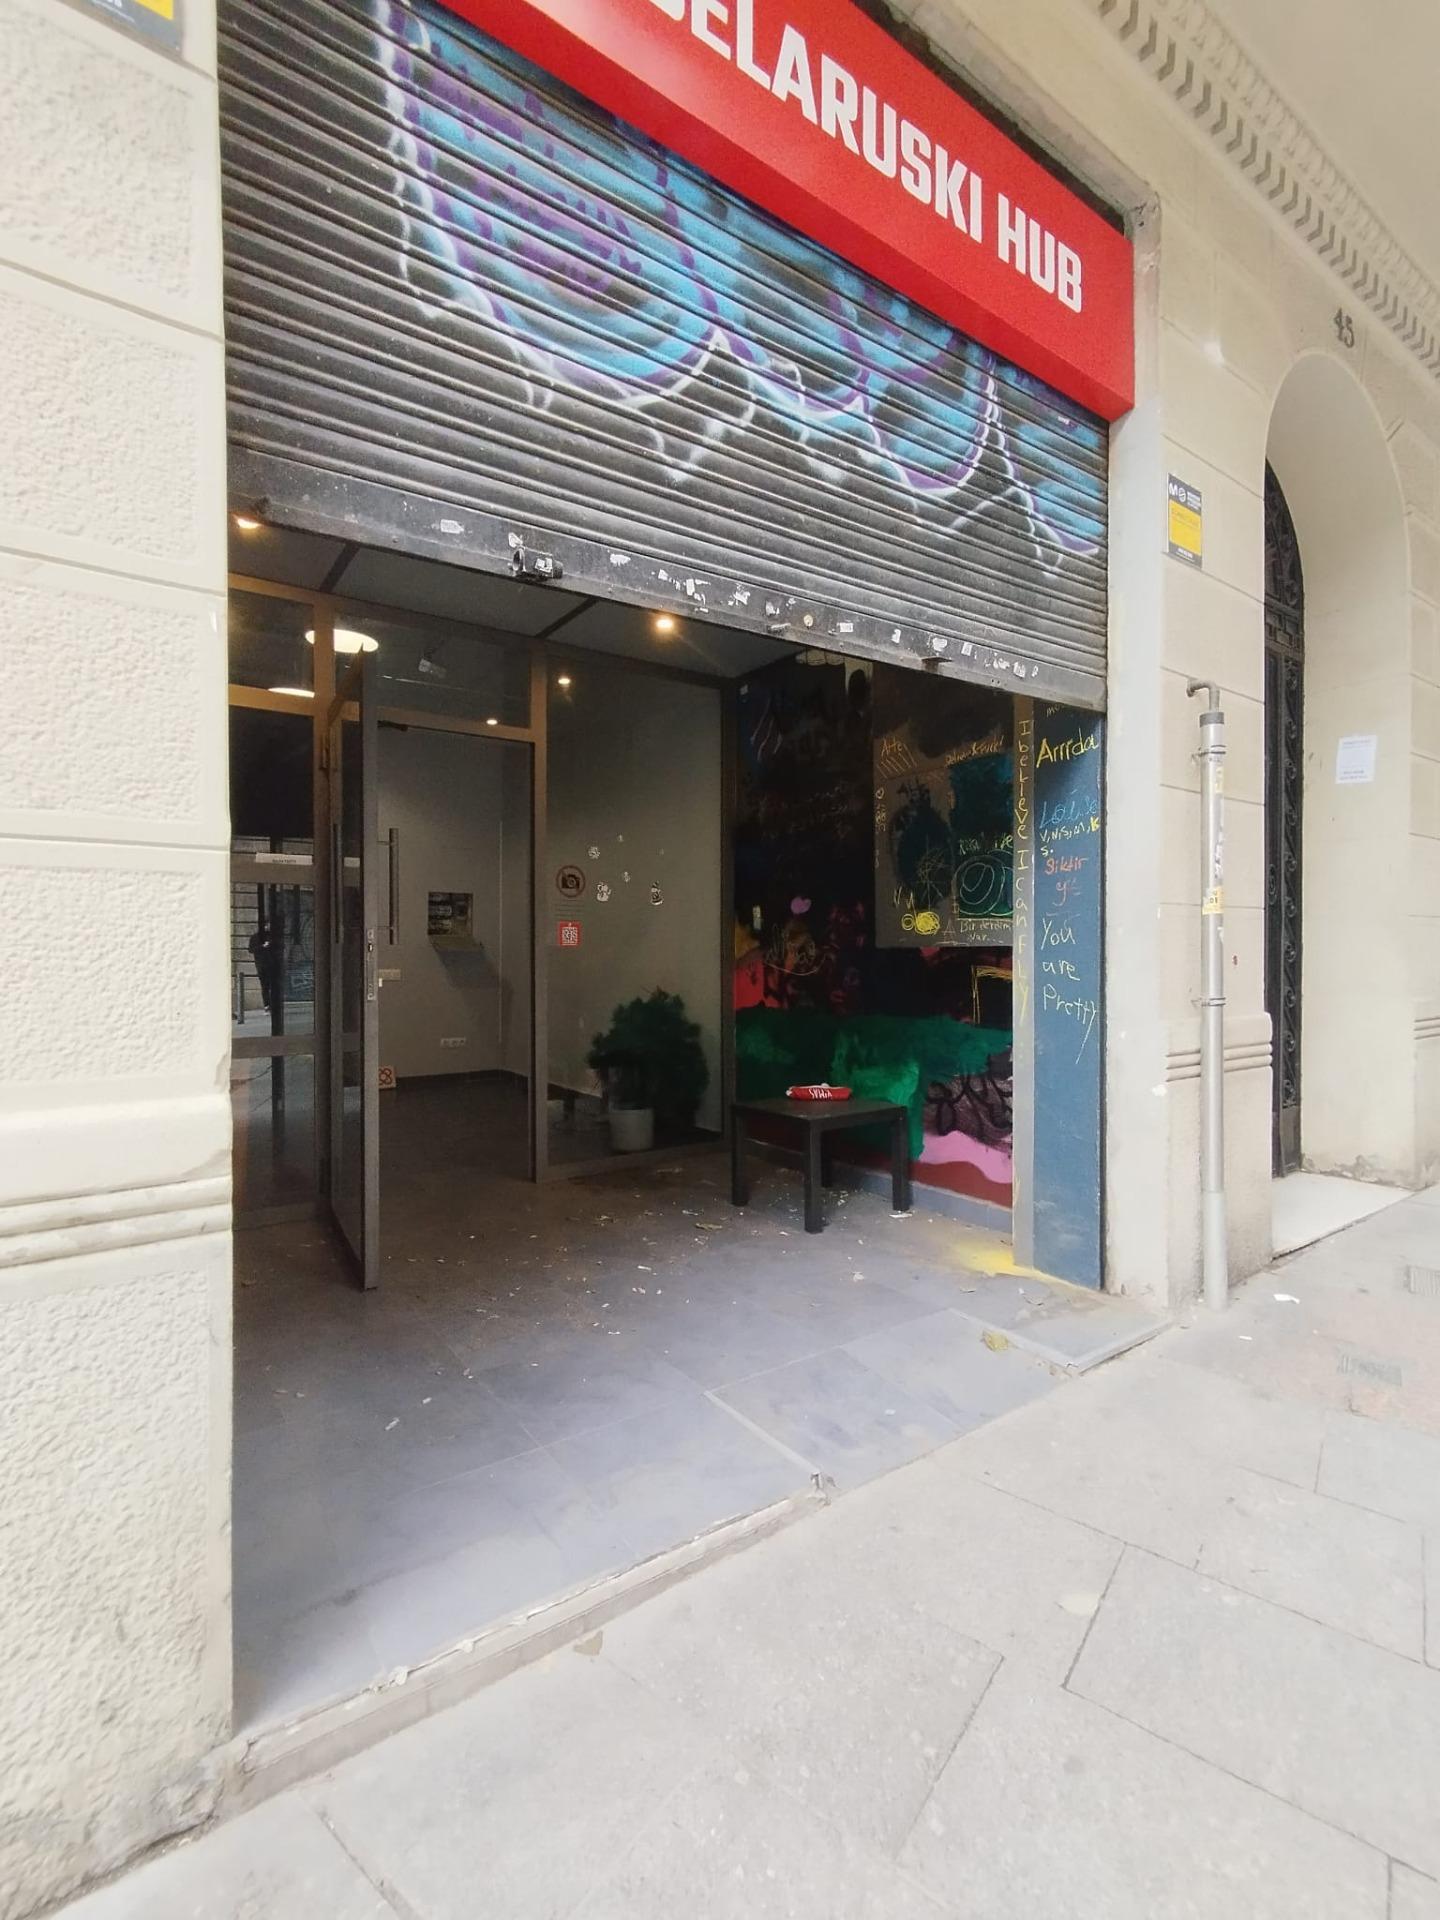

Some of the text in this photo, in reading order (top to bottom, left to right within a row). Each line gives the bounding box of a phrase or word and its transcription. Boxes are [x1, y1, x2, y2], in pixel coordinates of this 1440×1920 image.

[650, 0, 1083, 314] ELARUSKI HUB
[1333, 307, 1355, 348] 45
[1041, 917, 1076, 950] You
[1042, 959, 1081, 981] are
[1043, 973, 1097, 1065] Pretty
